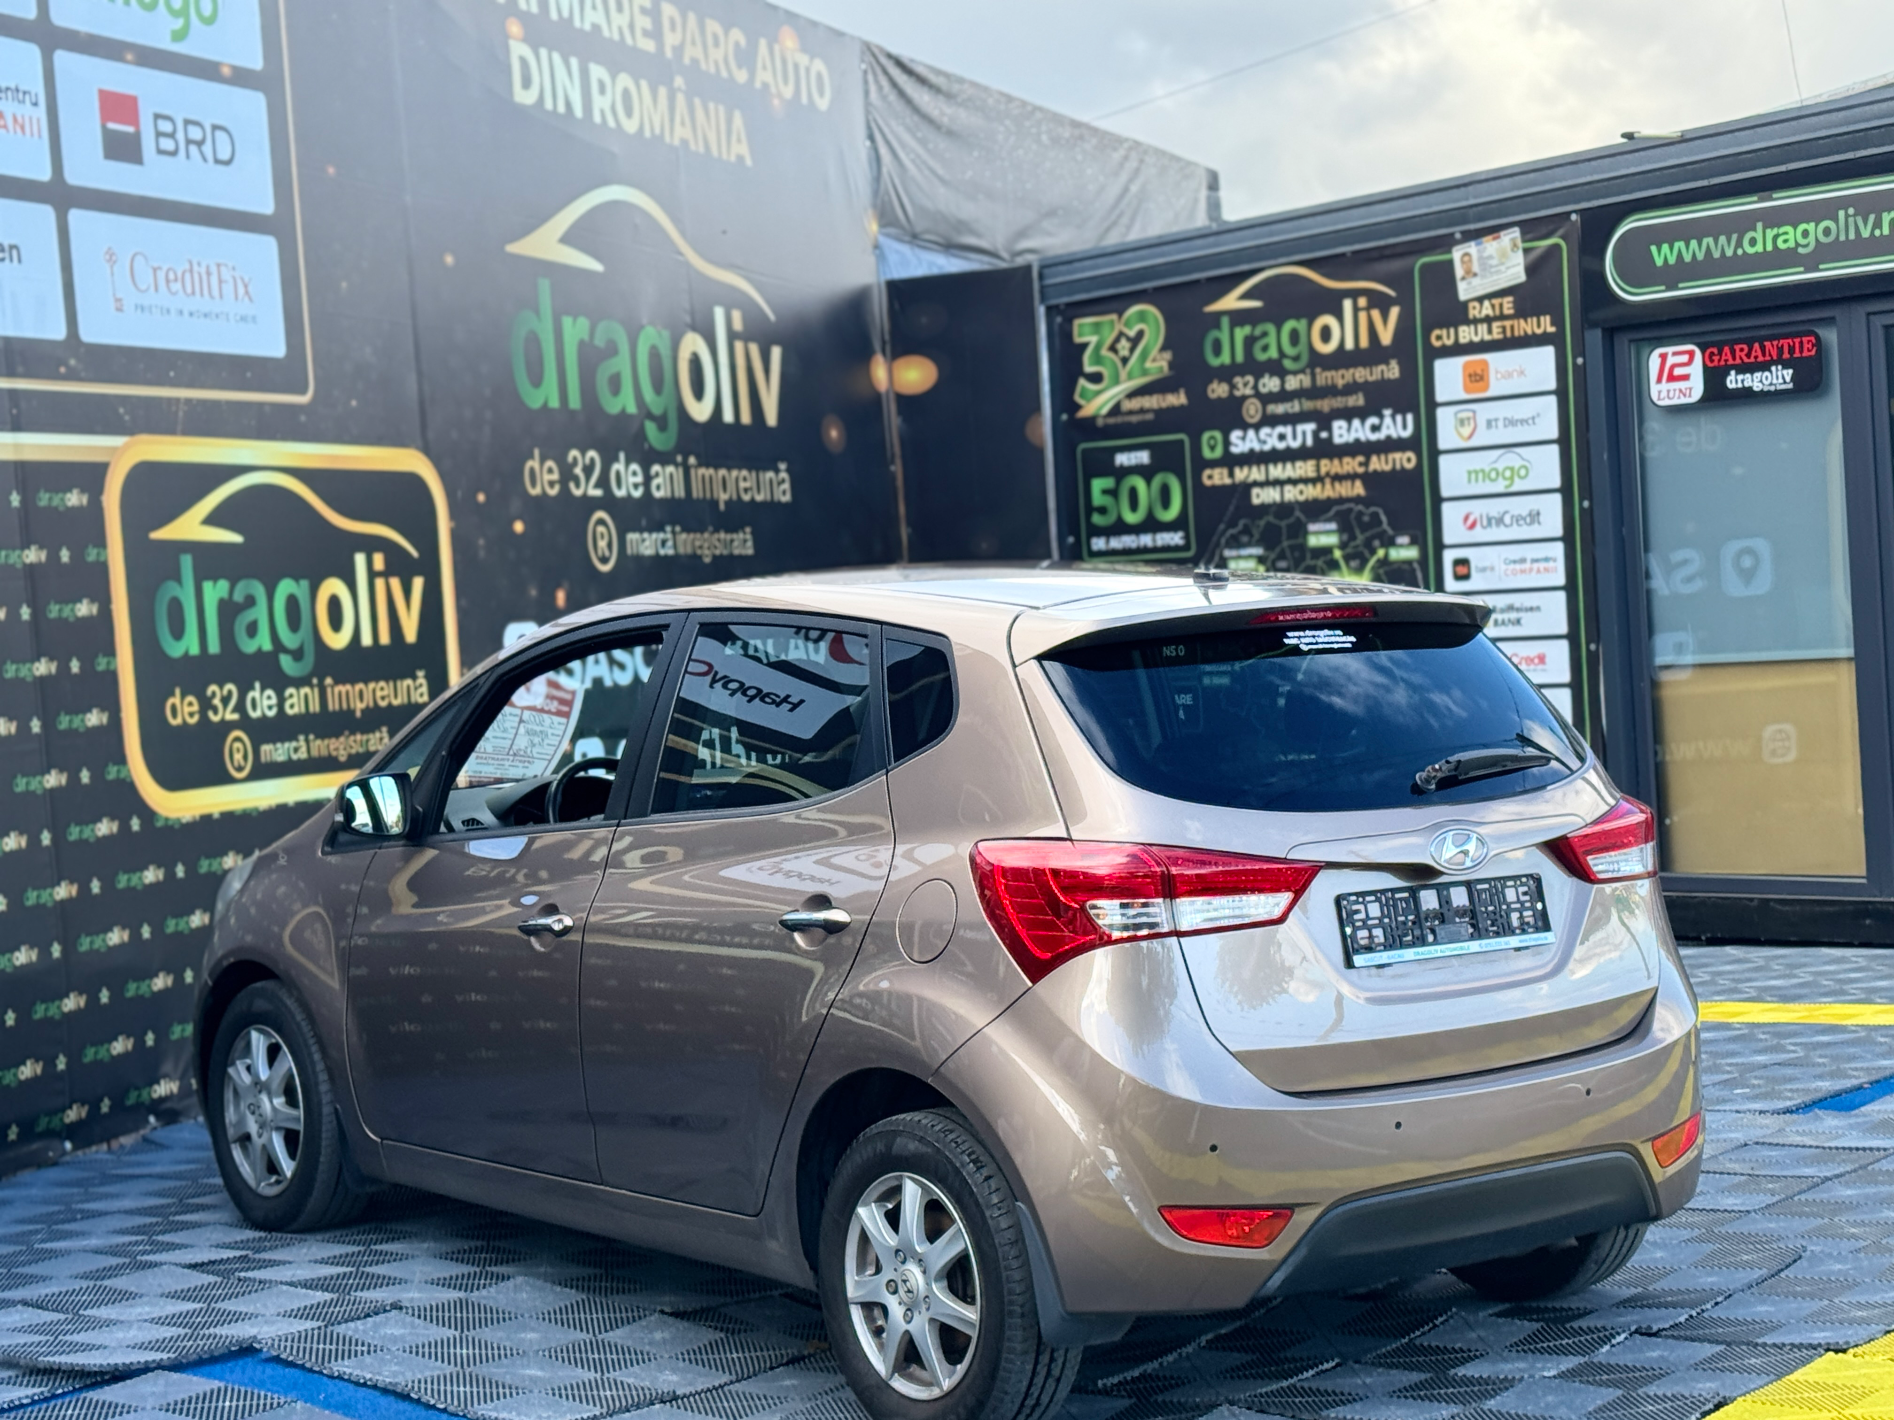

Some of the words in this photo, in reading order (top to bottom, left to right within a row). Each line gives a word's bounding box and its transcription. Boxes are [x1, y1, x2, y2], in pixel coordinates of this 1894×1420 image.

[660, 1, 749, 85] PARC
[754, 37, 831, 112] AUTO
[508, 39, 583, 119] DIN
[588, 61, 753, 167] ROMÂNIA
[153, 113, 235, 166] BRD
[129, 251, 254, 303] CreditFix
[1468, 296, 1515, 319] RATE
[1202, 296, 1400, 371] dragoliv
[1430, 327, 1455, 347] CU
[1457, 315, 1557, 344] BULETINUL
[511, 277, 782, 452] dragoliv
[1704, 335, 1817, 367] GARANTIE
[1207, 378, 1230, 399] de
[1232, 375, 1255, 397] 32
[1258, 373, 1281, 394] de
[1284, 368, 1311, 391] ani
[1315, 359, 1400, 389] împreună
[1468, 369, 1485, 384] tbi
[1495, 365, 1527, 381] bank
[1655, 349, 1696, 385] 12
[1726, 365, 1793, 391] dragoliv
[1656, 387, 1693, 401] LUNI
[1229, 422, 1316, 454] SASCUT
[1331, 408, 1414, 444] BACĂU
[1486, 416, 1500, 430] BT
[524, 448, 560, 497] de
[567, 448, 603, 497] 32
[610, 451, 644, 499] de
[650, 454, 685, 500] ani
[688, 454, 792, 512] împreună
[1201, 467, 1232, 487] CEL
[1233, 463, 1266, 484] MAI
[1268, 459, 1318, 481] MARE
[1320, 455, 1366, 476] PARC
[1368, 451, 1417, 472] AUTO
[1466, 463, 1530, 489] mogo
[36, 488, 89, 511] dragoliv
[1090, 470, 1183, 527] 500
[1251, 485, 1281, 505] DIN
[1283, 477, 1366, 502] ROMÂNIA
[1479, 509, 1542, 529] UniCredit
[626, 525, 674, 556] marcă
[1155, 530, 1186, 548] STOC
[46, 598, 99, 622] dragoliv
[154, 552, 425, 677] dragoliv
[2, 656, 58, 682] dragoliv
[165, 686, 200, 726] de
[206, 683, 240, 722] 32
[246, 681, 278, 718] de
[284, 677, 320, 716] ani
[324, 670, 430, 718] împreună
[56, 708, 109, 732] dragoliv
[260, 735, 308, 764] marcă
[12, 768, 68, 795] dragoliv
[66, 817, 119, 843] dragoliv
[115, 864, 165, 890] dragoliv
[23, 880, 78, 907] dragoliv
[164, 909, 211, 935] dragoliv
[76, 925, 130, 953] dragoliv
[124, 971, 174, 999] dragoliv
[31, 992, 87, 1020] dragoliv
[81, 1034, 135, 1064] dragoliv
[124, 1078, 181, 1107] dragoliv
[34, 1102, 90, 1133] dragoliv
